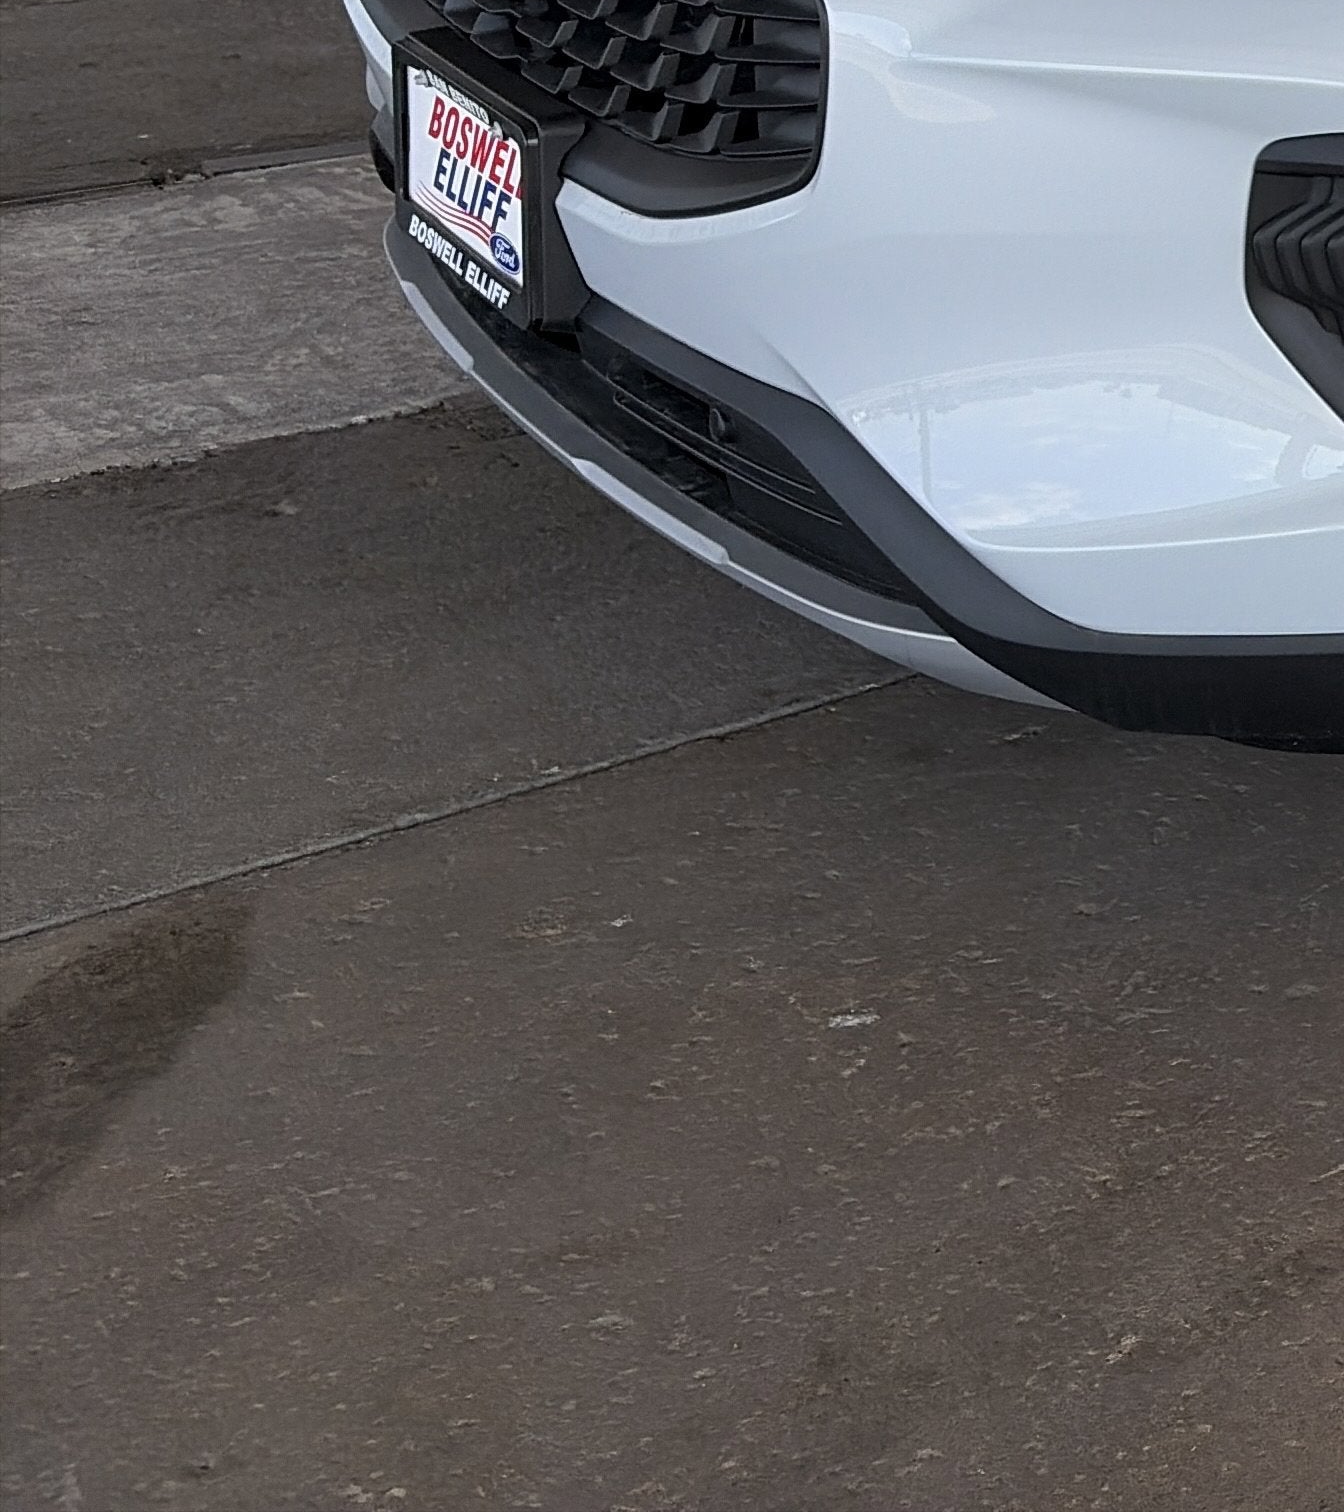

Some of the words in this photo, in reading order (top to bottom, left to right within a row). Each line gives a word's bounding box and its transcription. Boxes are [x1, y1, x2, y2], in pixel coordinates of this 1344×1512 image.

[428, 94, 523, 201] BOSWEL
[448, 84, 490, 125] BENITO
[433, 147, 512, 234] ELLIFF
[408, 214, 464, 277] BOSWELL
[464, 260, 511, 310] ELLIFF
[494, 238, 517, 269] Ford
